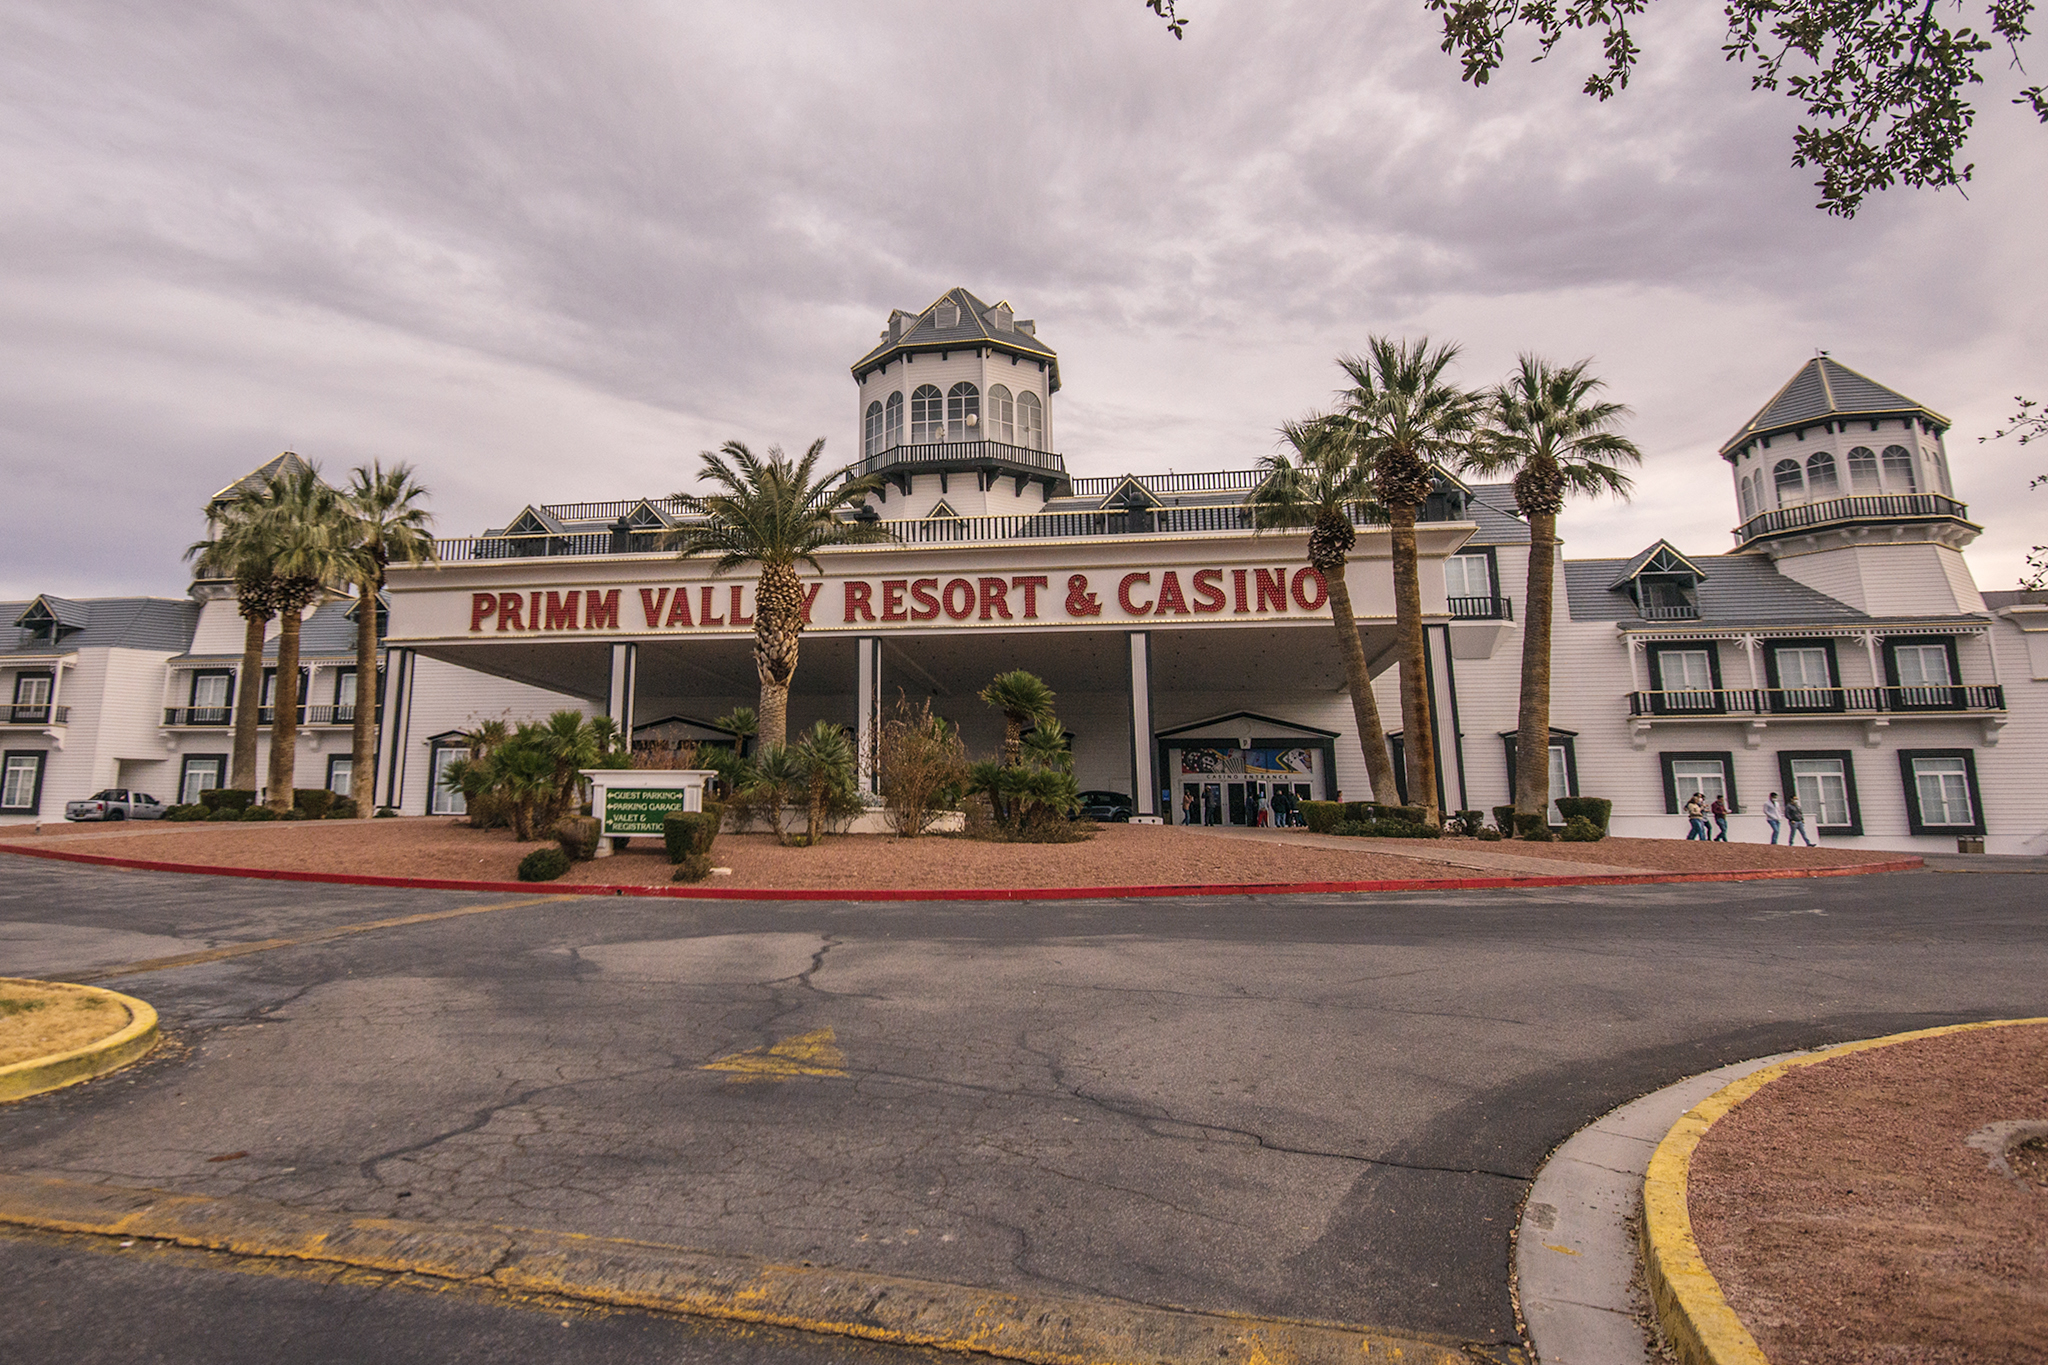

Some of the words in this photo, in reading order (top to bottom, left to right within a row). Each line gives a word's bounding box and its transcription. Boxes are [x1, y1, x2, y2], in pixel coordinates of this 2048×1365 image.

[469, 588, 622, 632] PRIMM
[638, 582, 823, 628] VALLY
[843, 575, 1048, 623] RESORT
[1065, 573, 1103, 617] &
[1117, 566, 1329, 616] CASINO
[614, 791, 641, 799] GUEST
[642, 791, 676, 800] PARKING
[613, 803, 647, 811] PARKING
[648, 803, 682, 811] GARAGE
[613, 814, 639, 822] VALET
[640, 814, 647, 822] &
